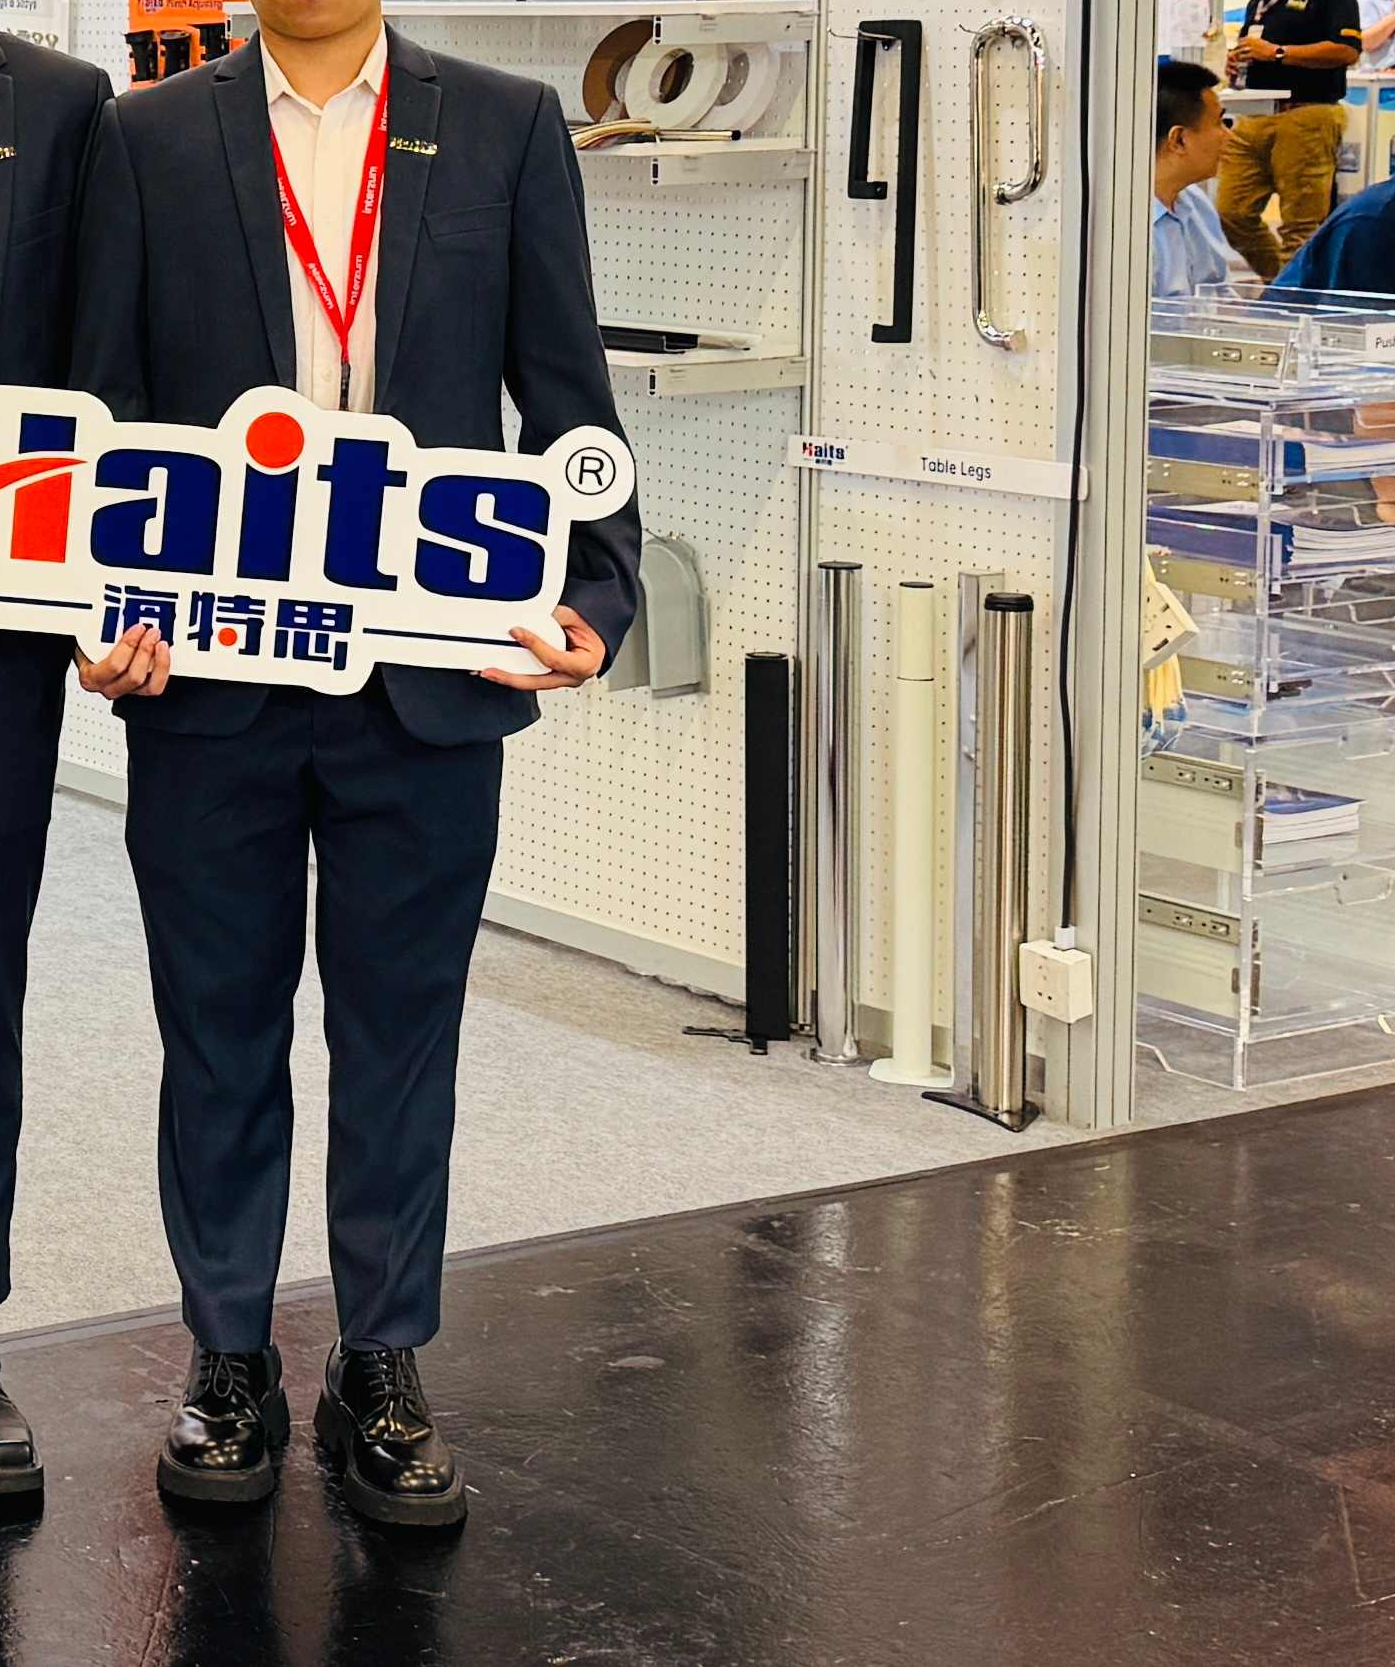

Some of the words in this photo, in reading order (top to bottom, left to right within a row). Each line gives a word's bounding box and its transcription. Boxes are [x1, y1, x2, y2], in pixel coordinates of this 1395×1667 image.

[362, 165, 379, 215] interzum
[349, 254, 363, 307] interzum
[802, 442, 846, 461] Haits
[921, 457, 955, 477] Table
[961, 458, 992, 481] Legs
[102, 584, 354, 671] 海特思
